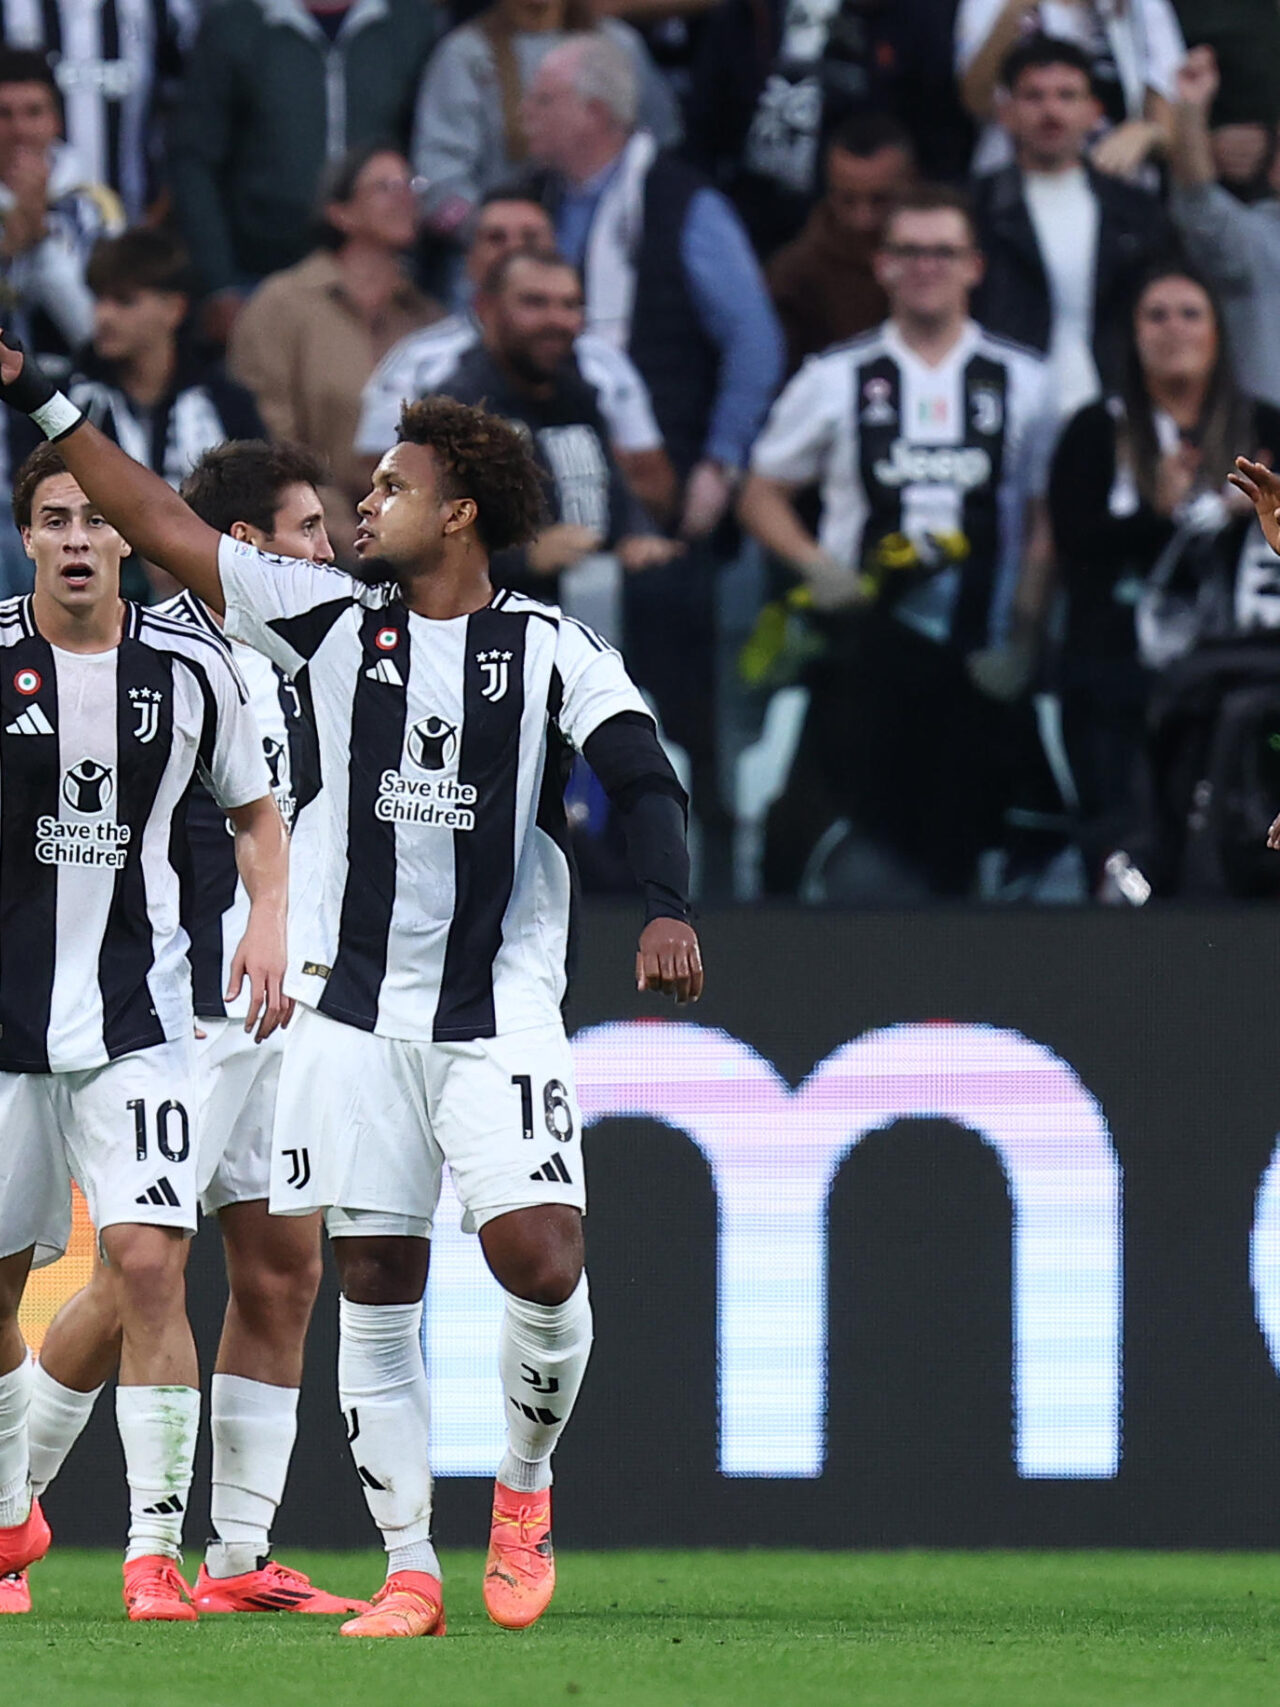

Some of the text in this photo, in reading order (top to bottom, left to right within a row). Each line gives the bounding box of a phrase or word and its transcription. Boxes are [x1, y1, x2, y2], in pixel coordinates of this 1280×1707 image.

[381, 771, 475, 802] Save the
[377, 797, 473, 827] Children
[38, 816, 129, 842] Save the
[37, 841, 127, 867] Children
[511, 1074, 574, 1143] 16
[126, 1098, 190, 1163] 10
